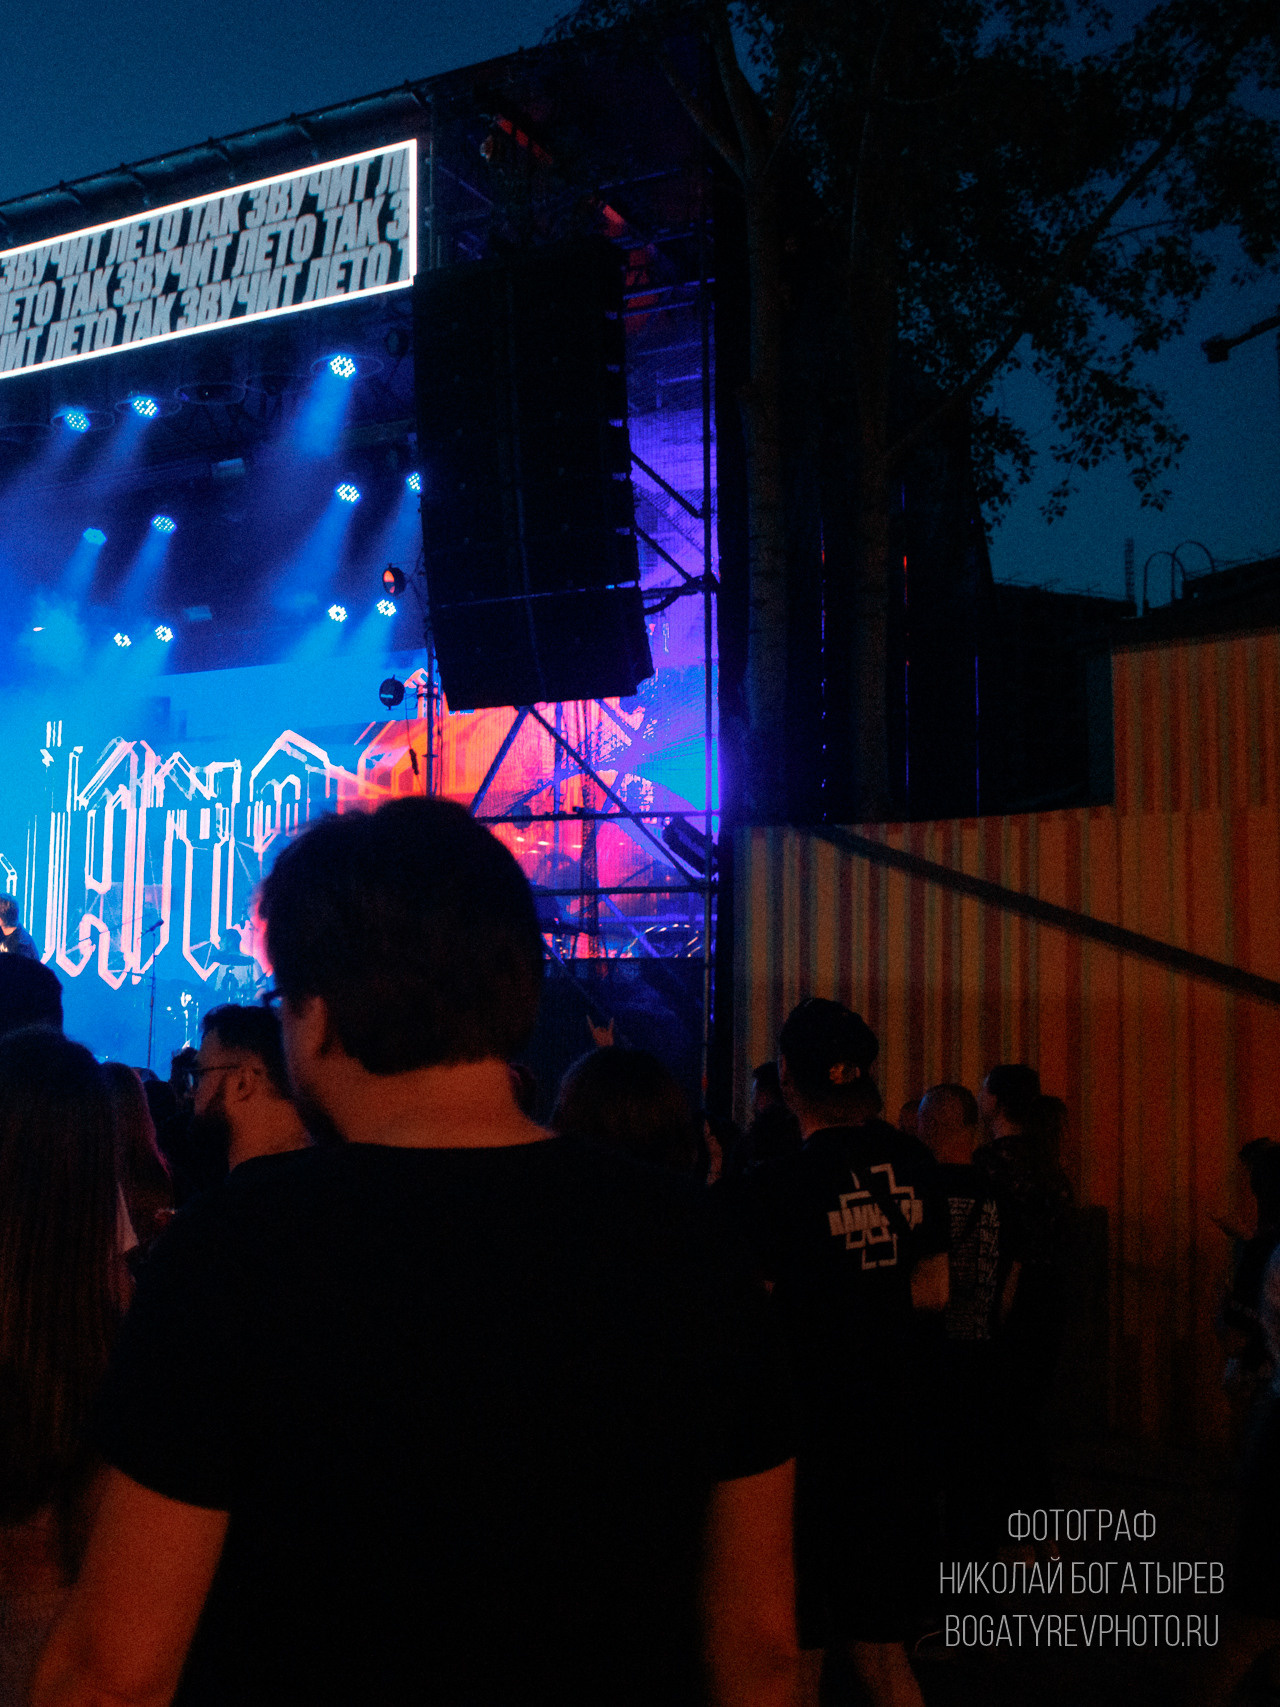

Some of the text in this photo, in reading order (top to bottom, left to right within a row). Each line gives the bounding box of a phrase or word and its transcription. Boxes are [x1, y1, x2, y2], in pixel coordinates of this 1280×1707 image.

[59, 264, 115, 321] ТАК
[112, 233, 234, 308] ЗВУЧИТ
[230, 213, 318, 279] ЛЕТО
[321, 195, 387, 258] ТАК
[105, 207, 184, 267] ЛЕТО
[186, 191, 245, 246] ТАК
[244, 156, 375, 230] ЗВУЧИТ
[41, 307, 118, 363] ЛЕТО
[121, 291, 178, 345] ТАК
[175, 261, 304, 333] ЗВУЧИТ
[301, 241, 392, 301] ЛЕТО
